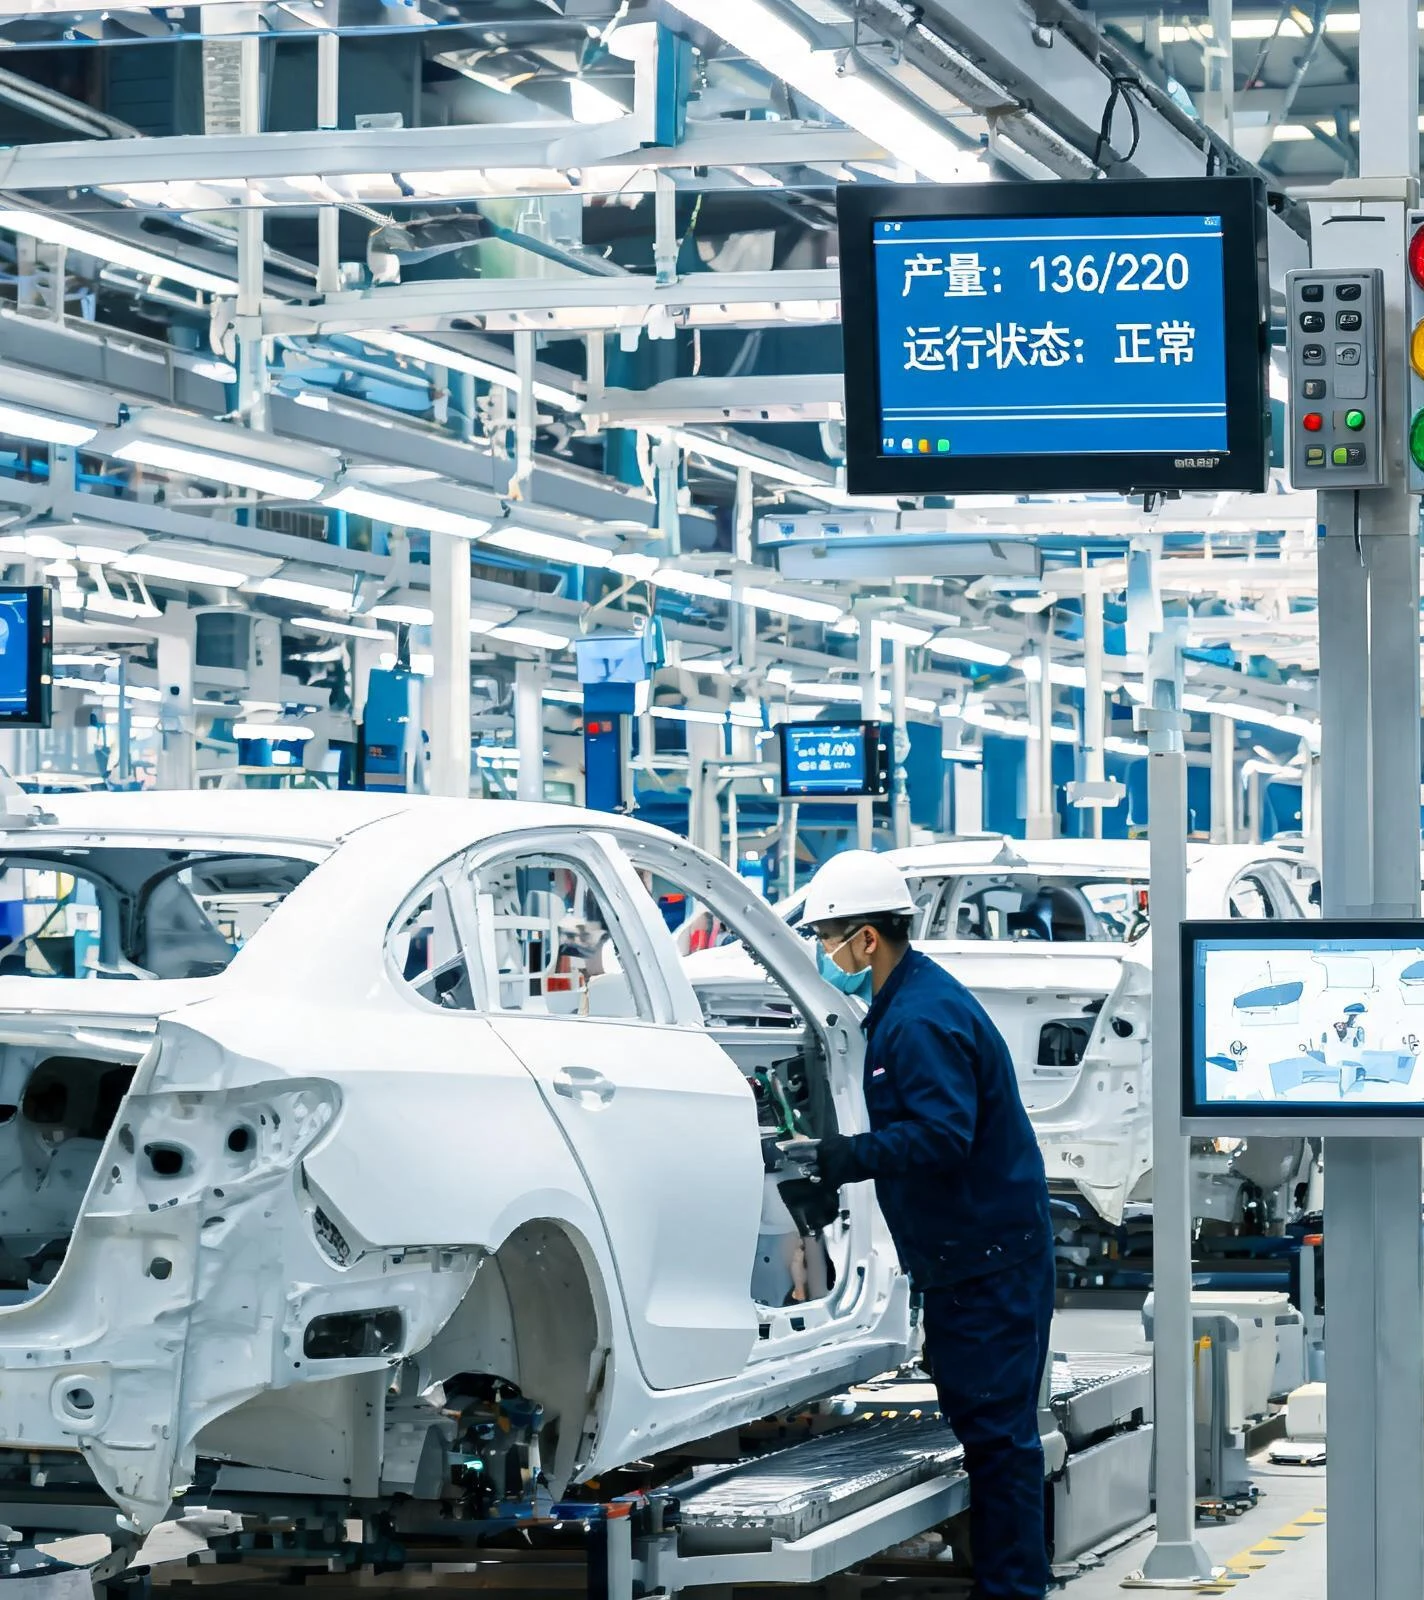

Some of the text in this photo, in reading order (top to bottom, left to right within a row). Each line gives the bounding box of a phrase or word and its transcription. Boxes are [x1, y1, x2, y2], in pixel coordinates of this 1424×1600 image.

[902, 252, 1190, 297] 产量： 136/220
[903, 320, 1196, 372] 运行状态： 正常
